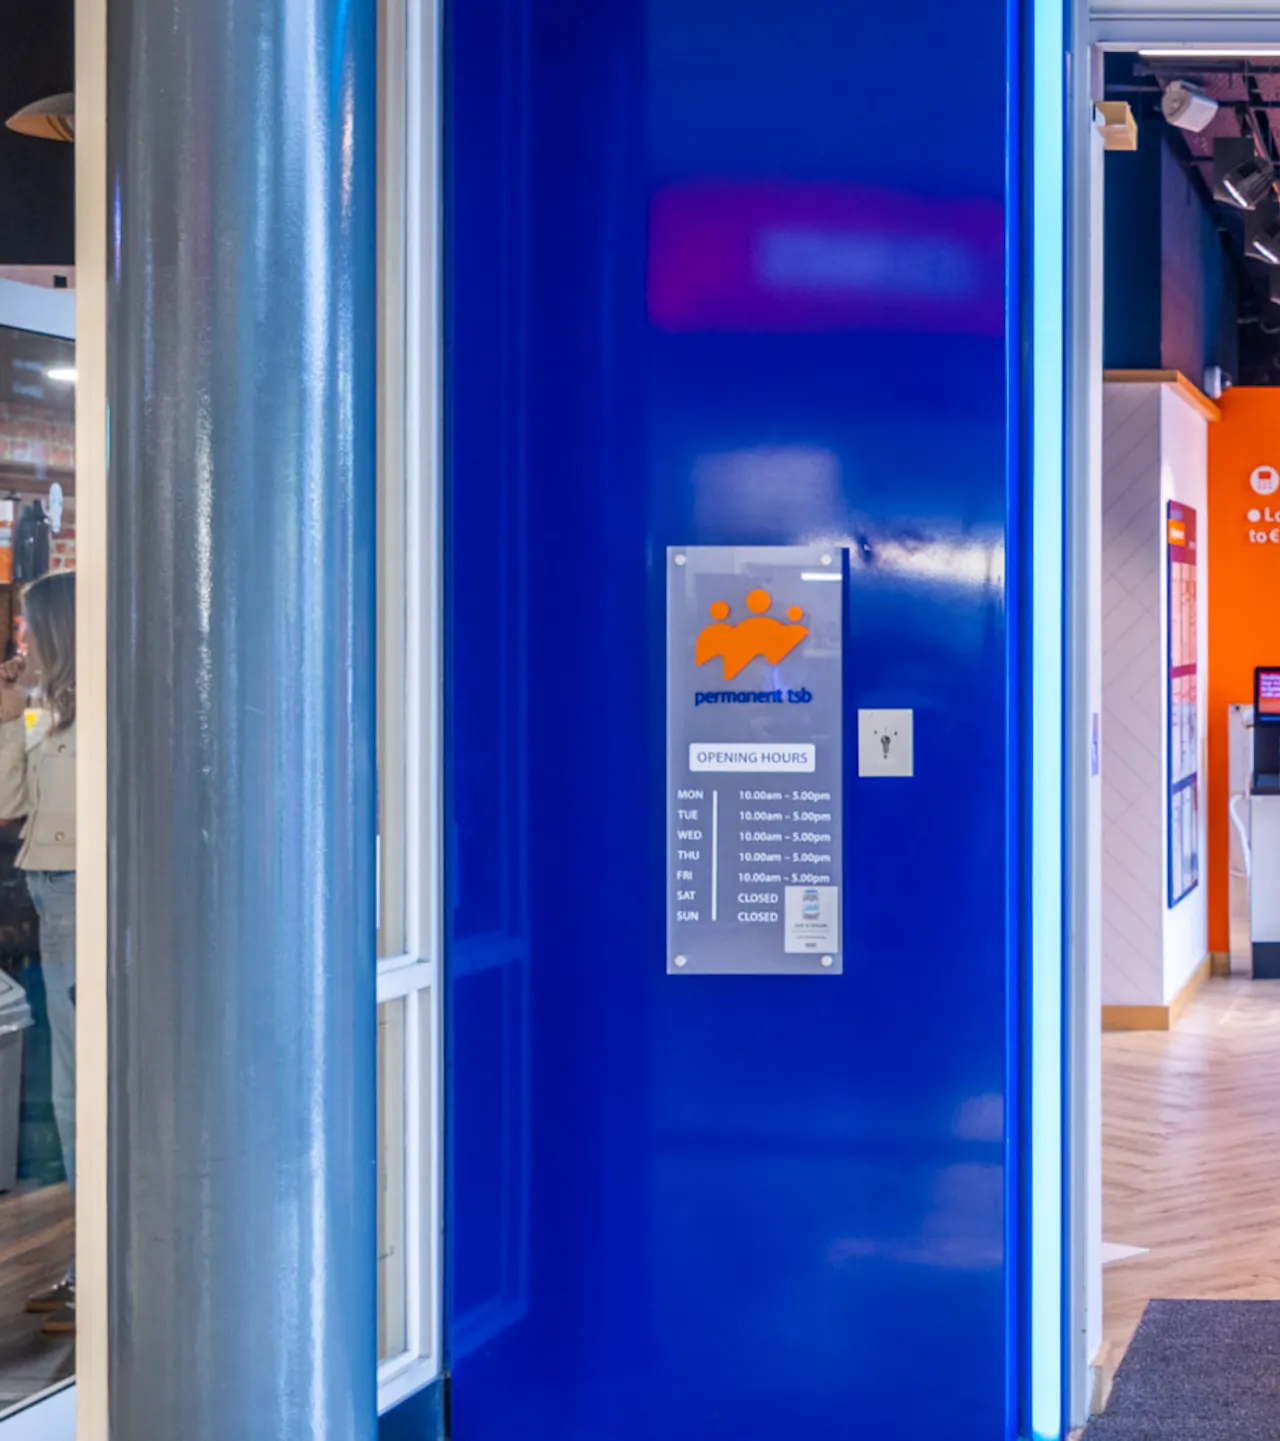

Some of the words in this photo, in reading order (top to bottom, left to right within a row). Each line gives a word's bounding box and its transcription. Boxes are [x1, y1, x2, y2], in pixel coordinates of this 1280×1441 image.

[1249, 529, 1267, 544] to
[1270, 529, 1280, 543] €
[694, 689, 784, 706] permanent
[787, 687, 813, 703] tsb
[697, 752, 757, 763] OPENING
[761, 752, 807, 763] HOURS
[677, 790, 703, 799] MON
[739, 791, 782, 800] 10.00am
[792, 791, 831, 802] 5.00pm
[678, 810, 698, 819] TUE
[739, 812, 783, 821] 10.00am
[792, 812, 831, 823] 5.00pm
[677, 830, 702, 840] WED
[739, 832, 782, 842] 10.00am
[792, 832, 831, 844] 5.00pm
[678, 851, 700, 860] THU
[739, 852, 782, 861] 10.00am
[792, 852, 831, 863] 5.00pm
[677, 871, 693, 880] FRI
[738, 873, 781, 882] 10.00am
[791, 873, 830, 884] 5.00pm
[677, 891, 696, 900] SAT
[737, 893, 779, 904] CLOSED
[677, 912, 699, 921] SUN
[737, 912, 778, 922] CLOSED
